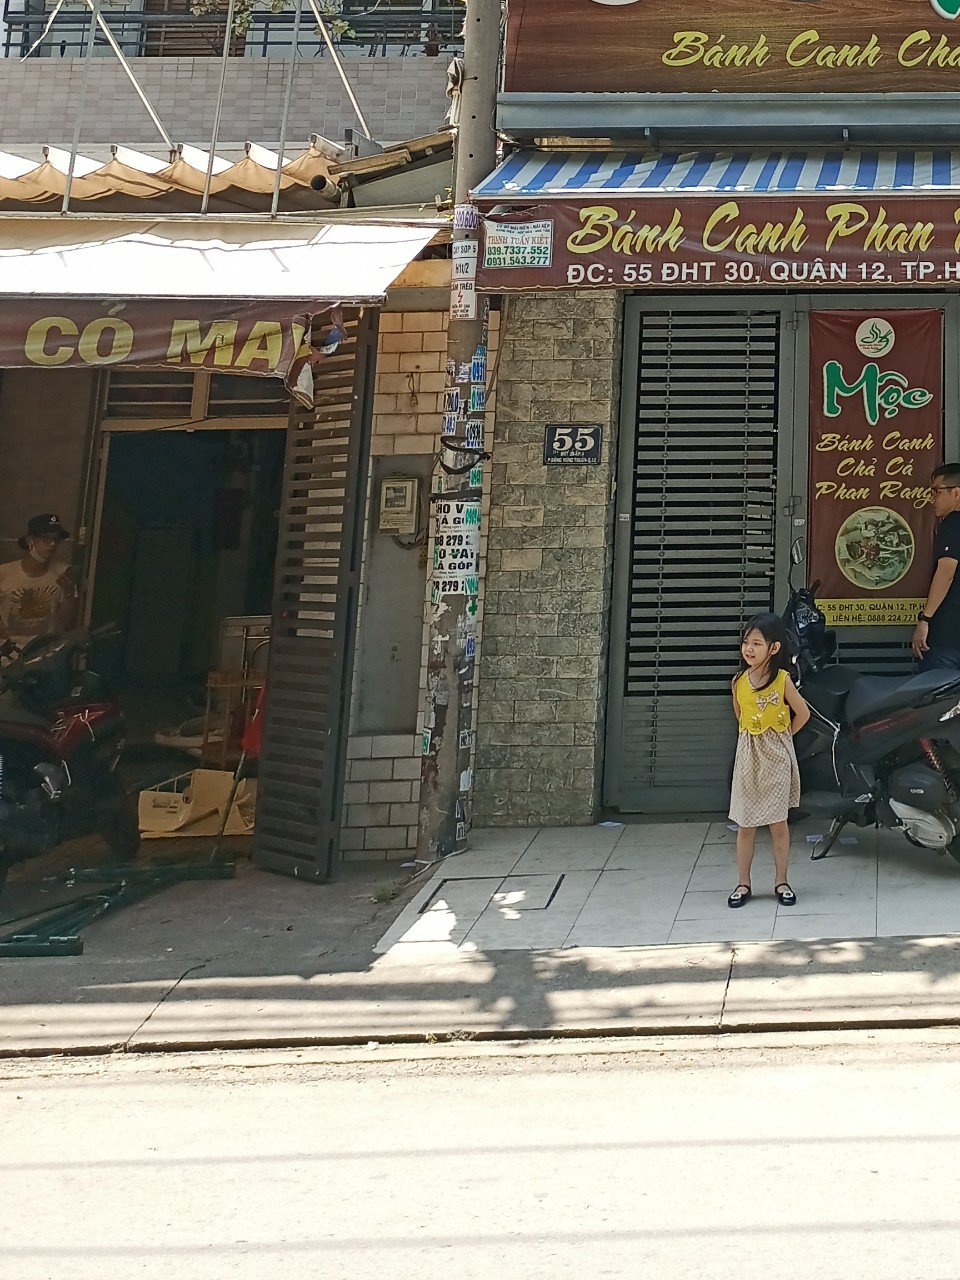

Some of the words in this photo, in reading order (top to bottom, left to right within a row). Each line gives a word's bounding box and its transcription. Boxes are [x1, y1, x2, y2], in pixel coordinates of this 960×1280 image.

[660, 30, 771, 68] Bánh
[785, 29, 883, 68] Canh
[566, 205, 687, 255] Bánh
[702, 201, 809, 255] Canh
[825, 203, 935, 254] Phan
[566, 263, 614, 283] ĐC:
[622, 262, 652, 282] 55
[661, 262, 717, 281] ĐHT
[724, 261, 762, 283] 30,
[857, 261, 893, 282] 12,
[24, 300, 134, 366] CỎ
[823, 360, 934, 426] Mộc
[552, 427, 595, 451] 55
[815, 432, 875, 452] Bánh
[882, 431, 936, 451] Canh
[836, 457, 878, 477] Chả
[885, 456, 914, 476] Cá
[815, 481, 870, 500] Phan
[879, 480, 934, 509] Rang
[446, 534, 463, 546] 279
[448, 561, 473, 570] GÓP
[441, 580, 459, 592] 279
[909, 603, 925, 611] TP.H
[867, 614, 886, 622] 0888
[887, 614, 901, 622] 224
[904, 614, 917, 622] 771
